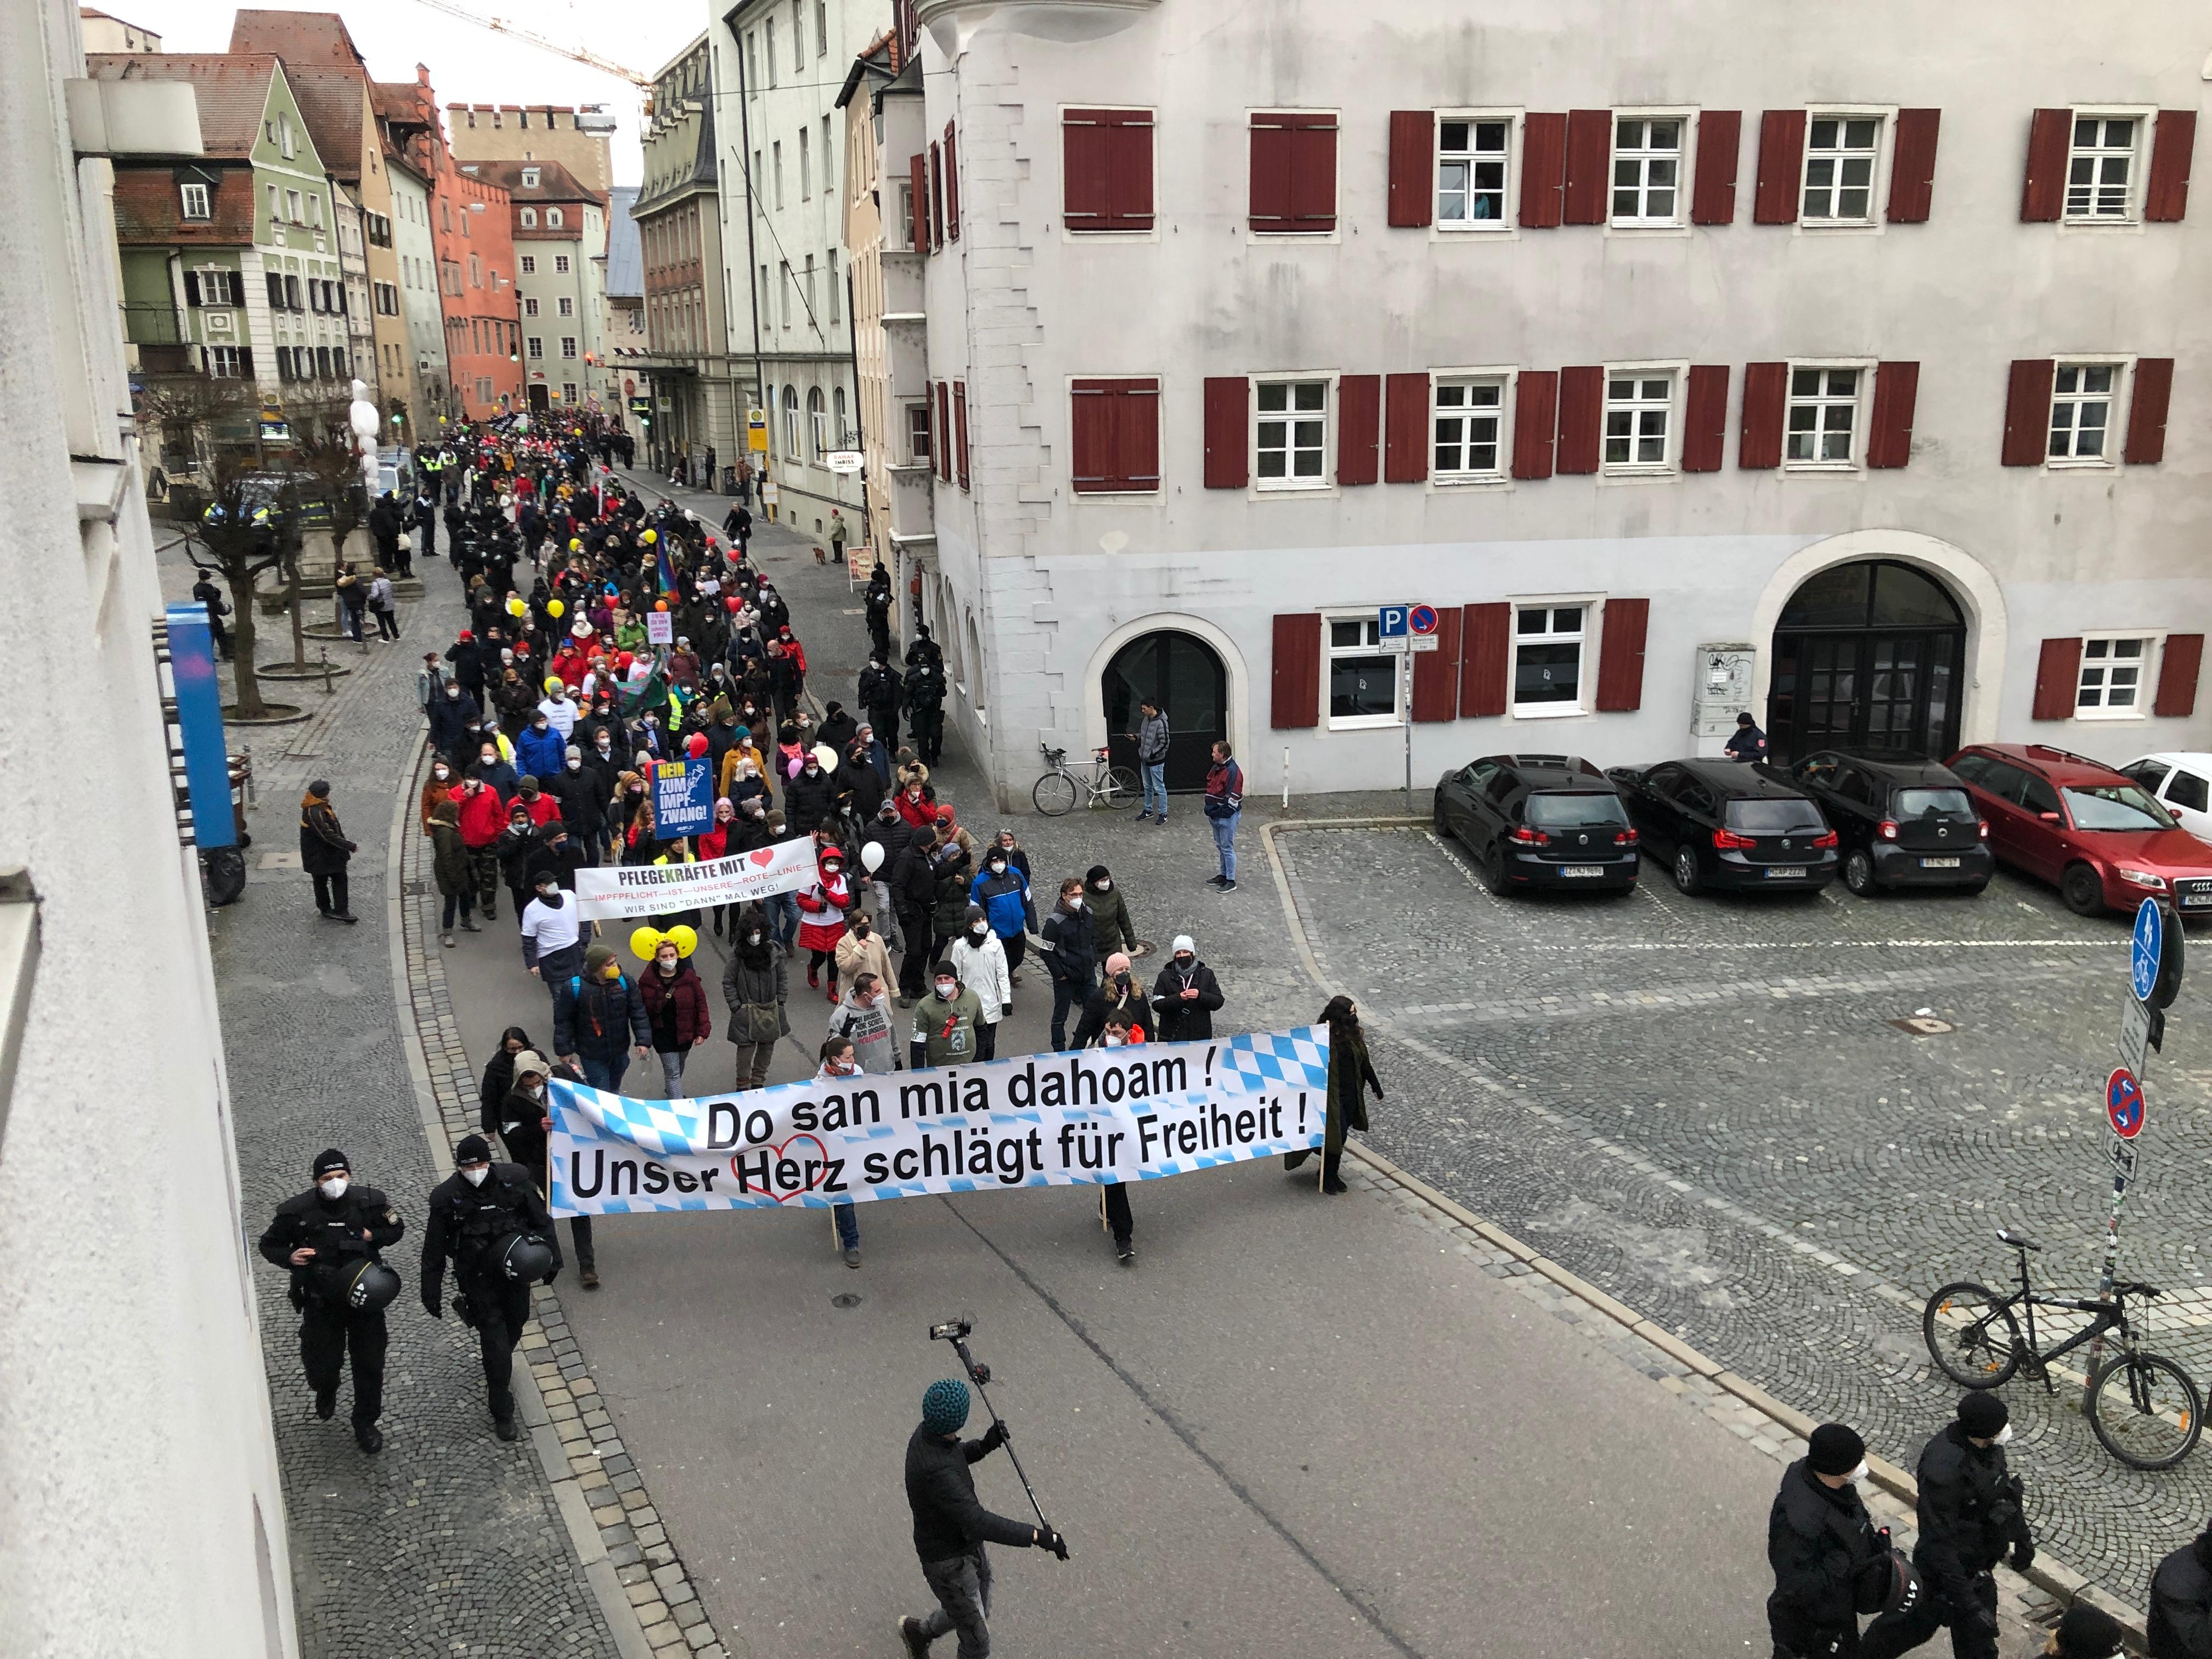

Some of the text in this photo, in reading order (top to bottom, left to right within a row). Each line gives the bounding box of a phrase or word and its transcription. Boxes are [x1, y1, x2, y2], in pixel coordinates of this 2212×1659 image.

[1386, 611, 1401, 633] P
[658, 761, 685, 779] NEIN
[659, 777, 686, 794] ZUM
[659, 792, 696, 810] IMPF-
[661, 805, 708, 825] ZWANG!
[618, 857, 746, 887] PFLEGEKRÄFTE MIT
[594, 890, 659, 902] IMPFPFLICHT
[692, 882, 734, 893] UNSERE
[742, 874, 769, 884] ROTE
[777, 864, 803, 877] LINIE
[624, 883, 780, 914] WIR SIND "DANN" MAL WEG!
[856, 1017, 884, 1031] NUR SCHUTZ
[864, 1011, 882, 1022] BRAUCHE
[856, 1023, 887, 1038] VOR UNSEREN
[707, 1046, 1217, 1150] Do san mia dahoam !
[571, 1092, 1307, 1199] Unser Herz schlägt für Freiheit !
